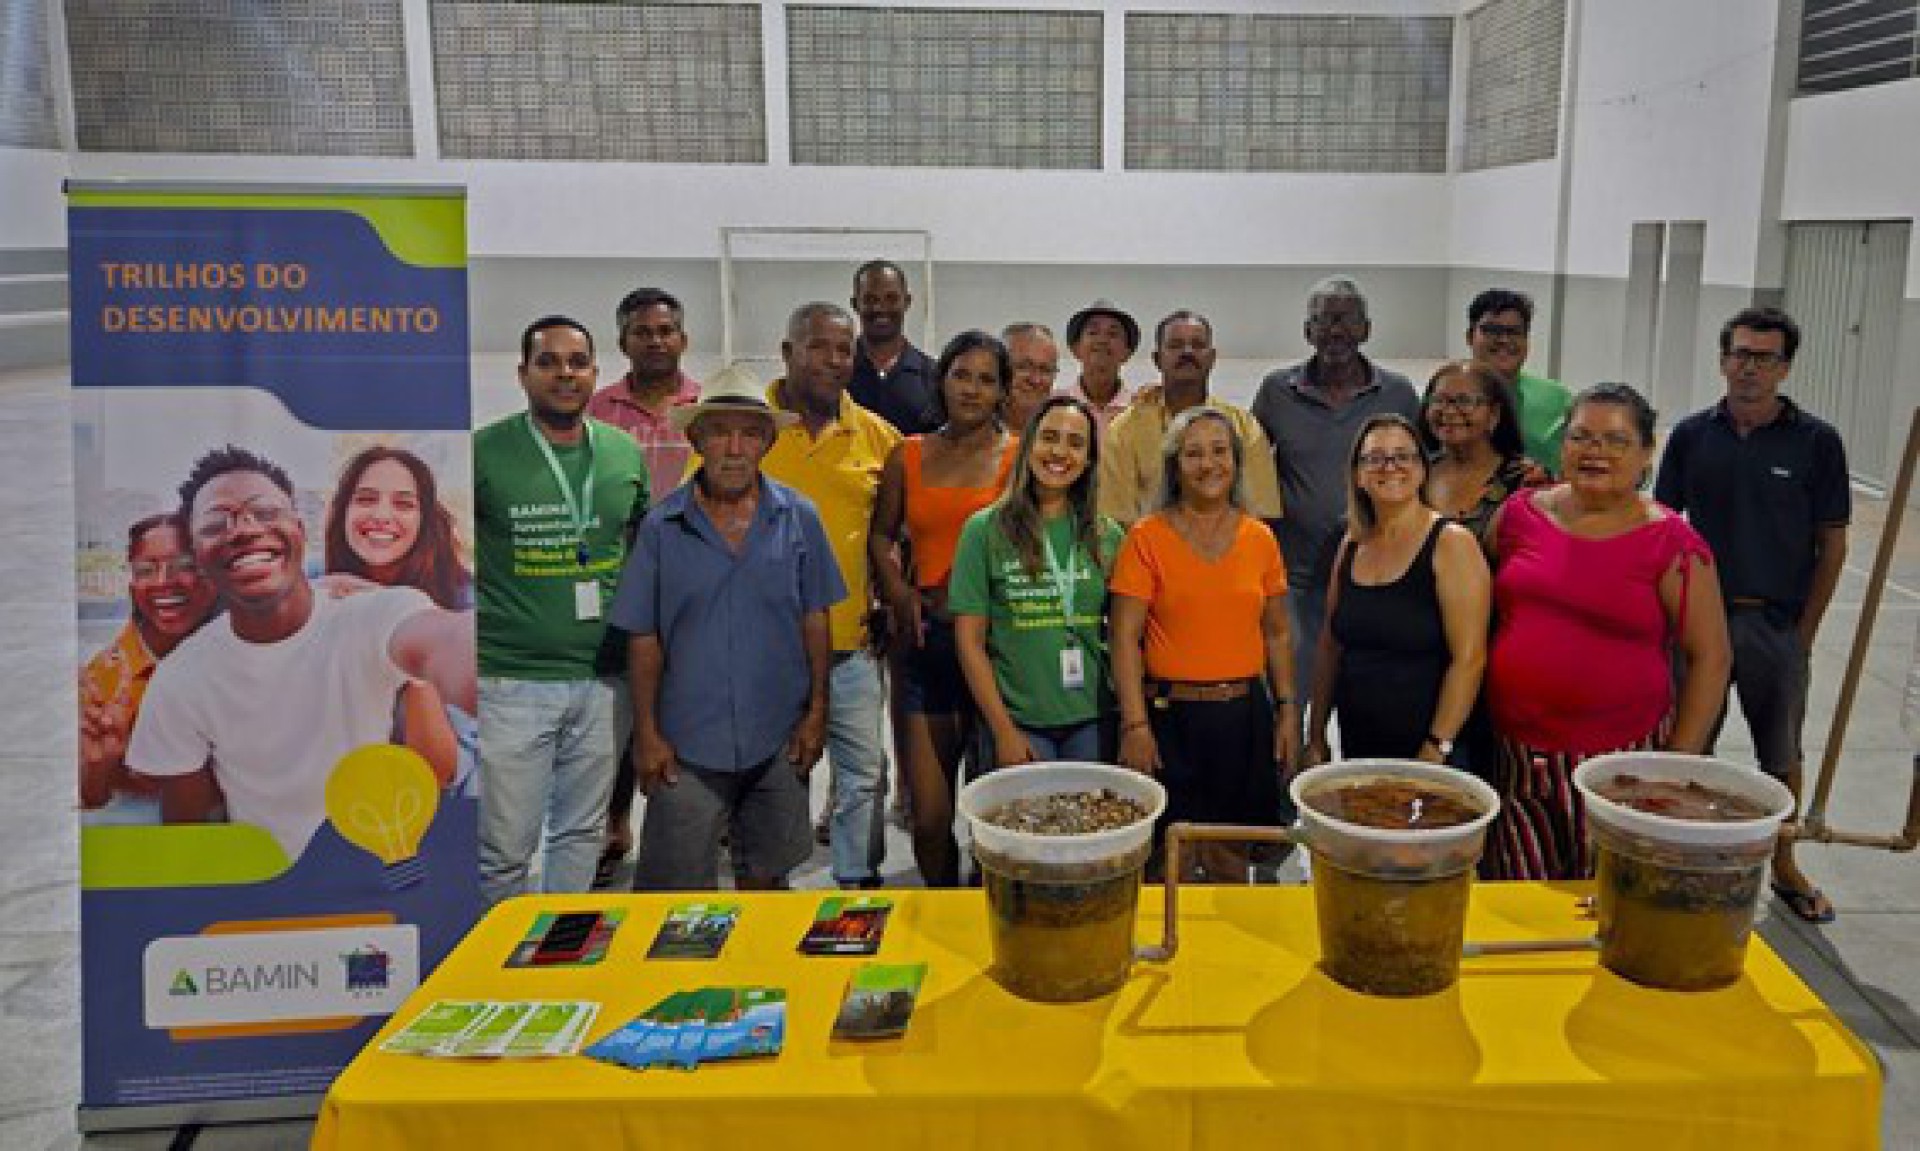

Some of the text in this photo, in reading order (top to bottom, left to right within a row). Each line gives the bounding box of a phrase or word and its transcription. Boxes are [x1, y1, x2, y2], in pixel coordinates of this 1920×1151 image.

[102, 262, 308, 289] TRILHOS DO
[102, 305, 440, 334] DESENVOLVIMENTO
[205, 963, 319, 995] BAMIN
